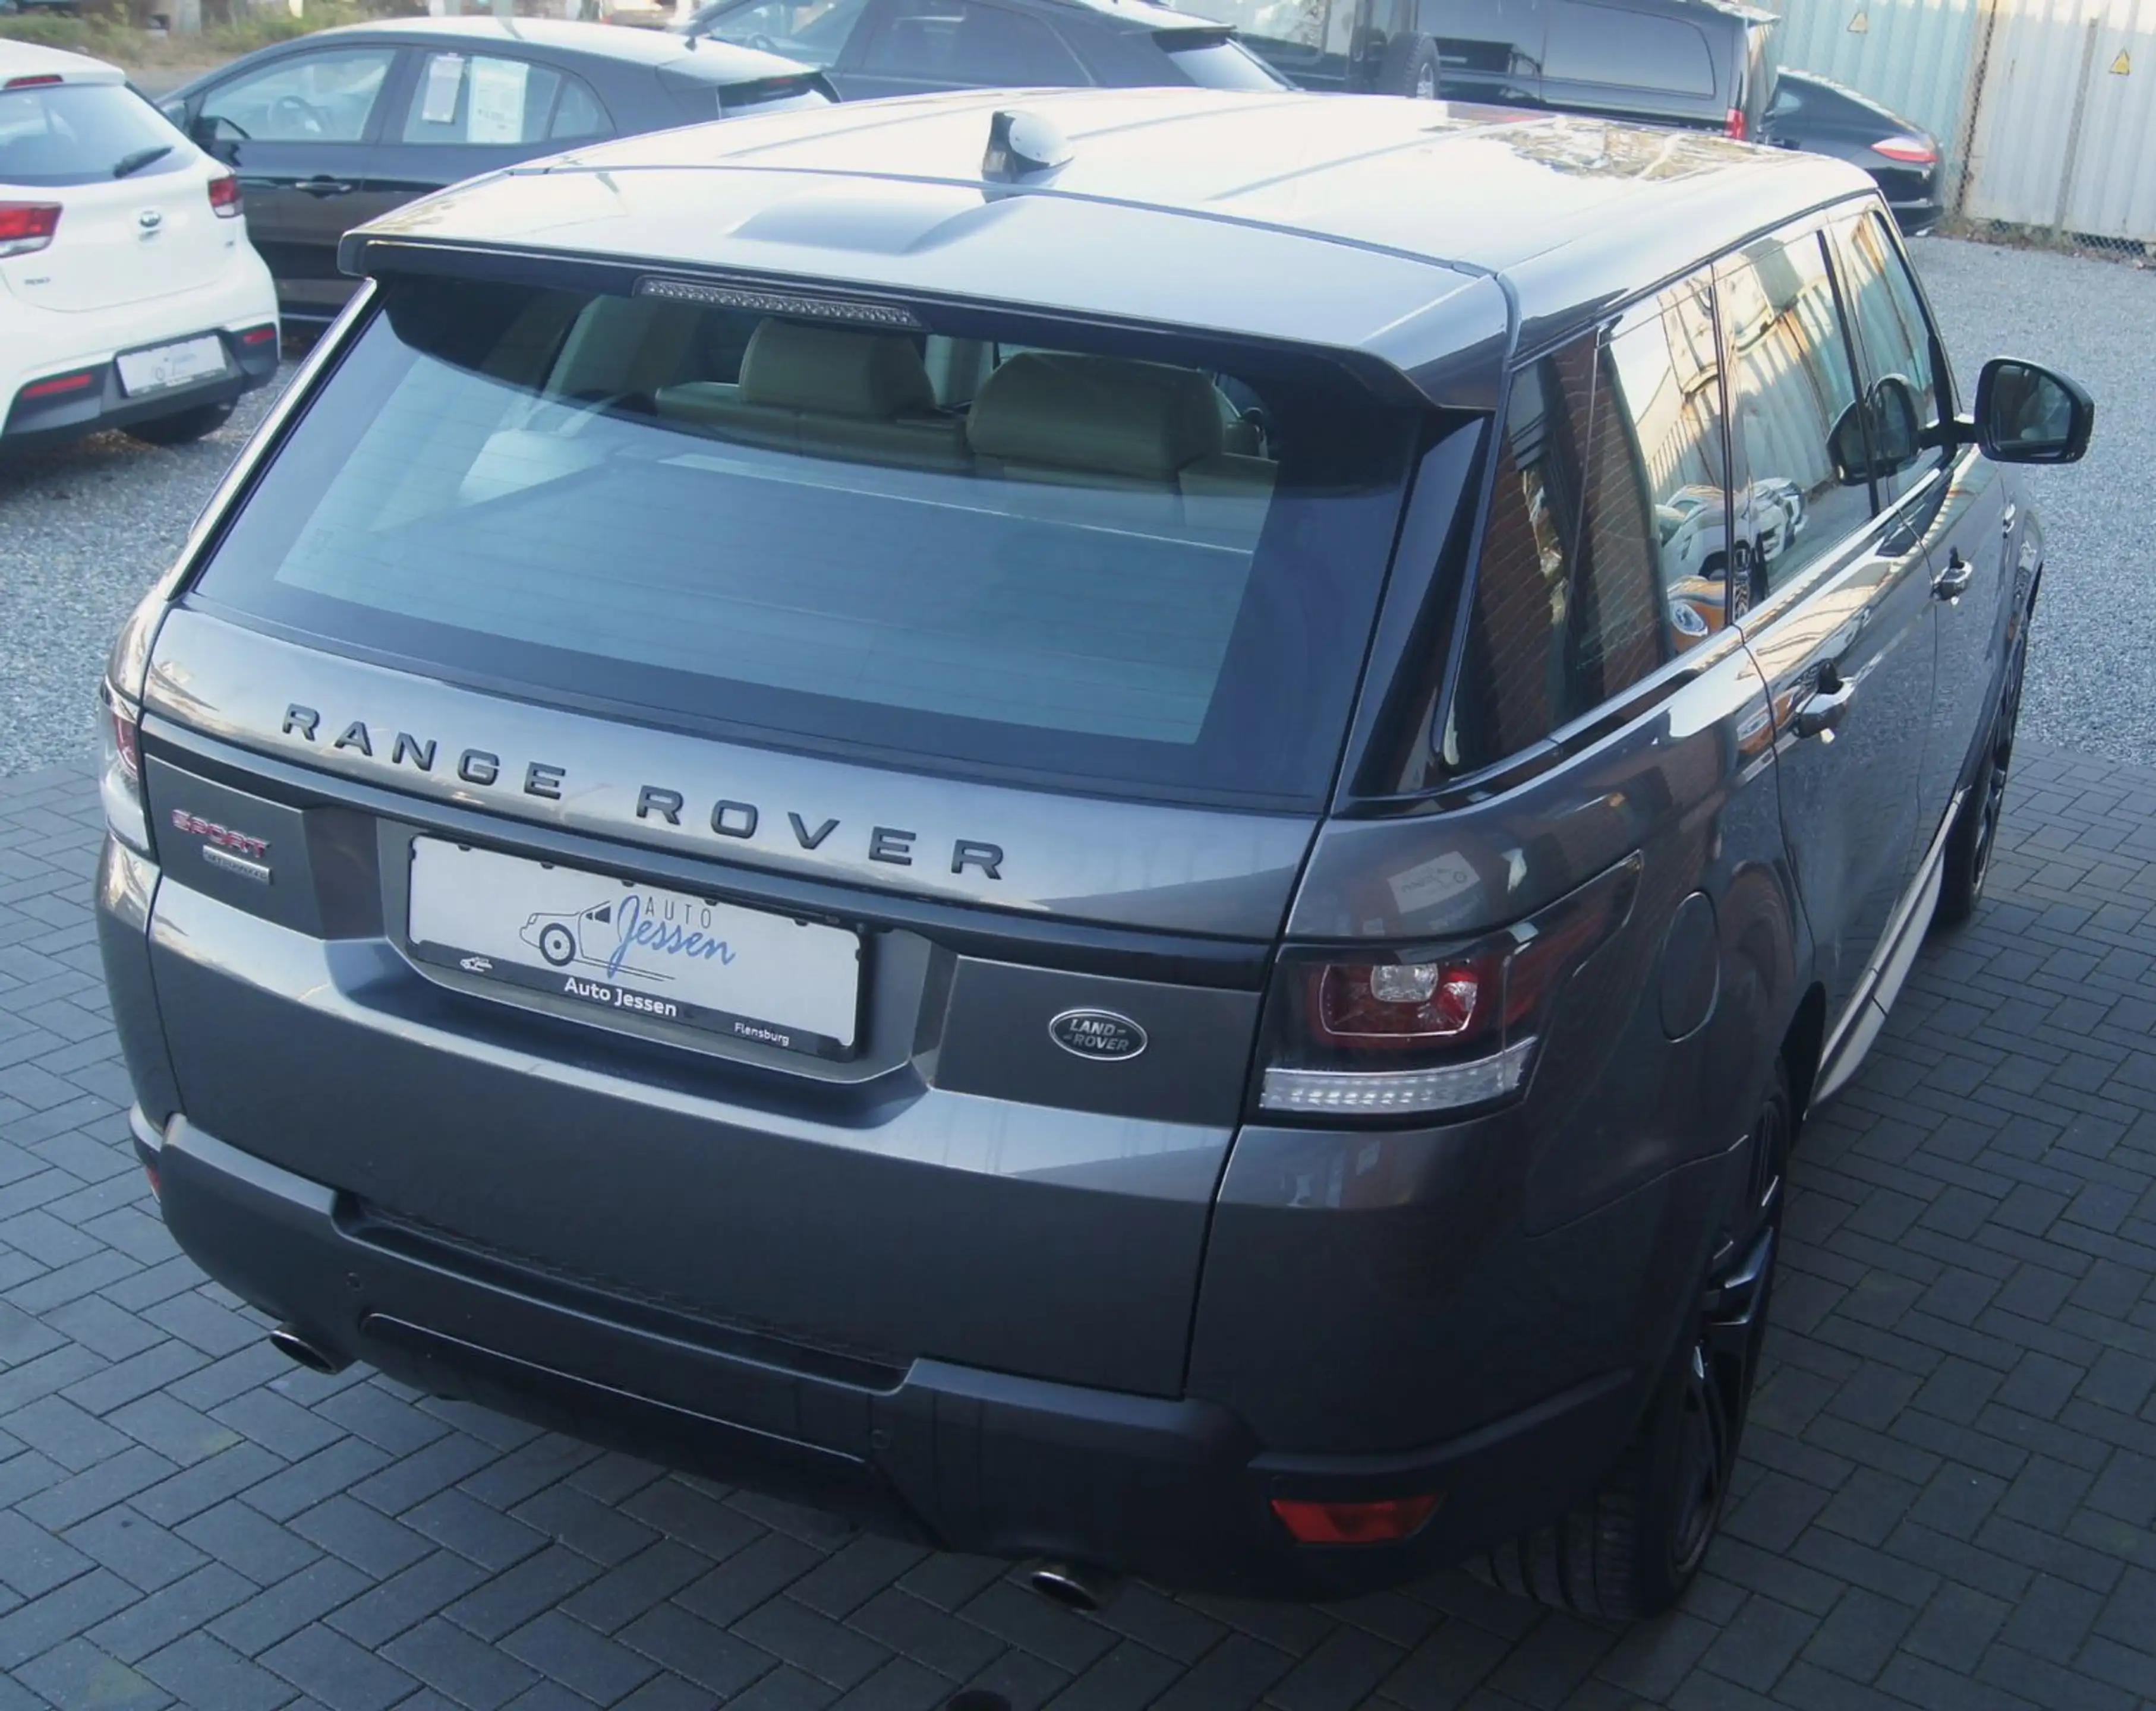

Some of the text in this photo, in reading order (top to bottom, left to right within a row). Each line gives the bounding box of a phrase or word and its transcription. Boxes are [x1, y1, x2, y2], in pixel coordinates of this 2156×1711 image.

[282, 703, 1004, 880] RANGE ROVER
[172, 809, 271, 858] SPORT
[645, 897, 711, 929] AUTO
[607, 895, 736, 978] Jessen
[564, 977, 677, 1017] Auto Jessen
[734, 1022, 790, 1047] Flensburg
